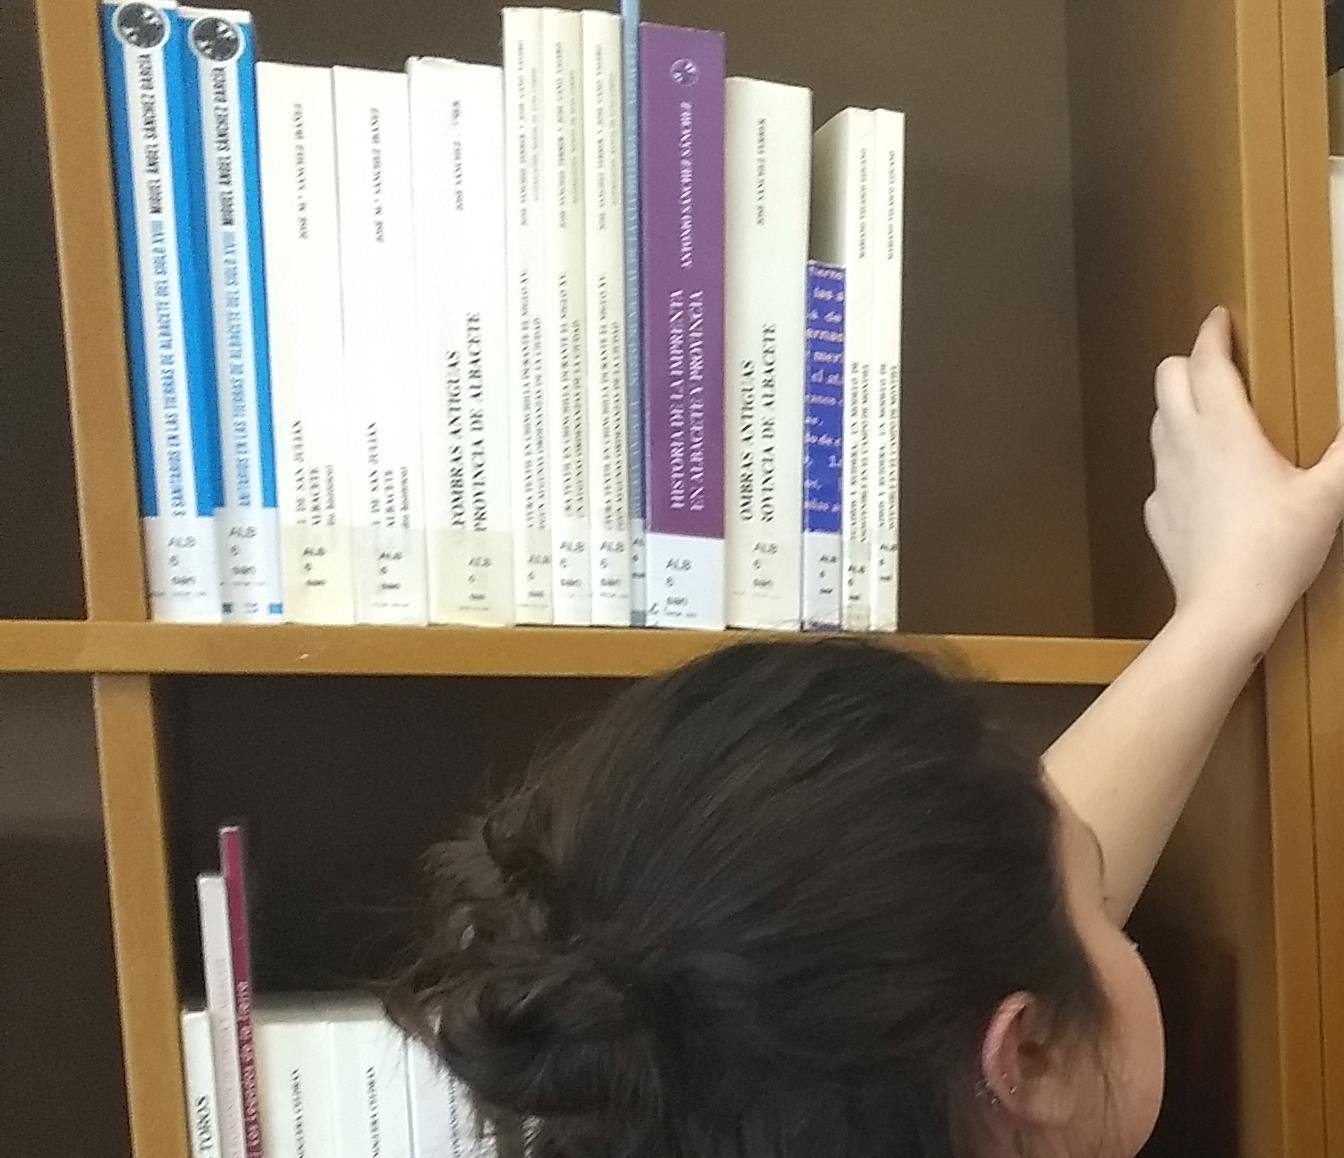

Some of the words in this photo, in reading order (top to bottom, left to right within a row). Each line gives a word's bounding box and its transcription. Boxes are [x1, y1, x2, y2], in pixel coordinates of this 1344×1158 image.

[147, 176, 163, 213] MIGUEL
[680, 214, 692, 266] ANTONIO
[155, 279, 169, 296] DEL
[157, 301, 173, 351] ALBACETE
[670, 289, 684, 374] IMPRENTA
[688, 290, 703, 379] PROVINCIA
[161, 354, 174, 365] DE
[466, 311, 485, 398] ALBACETE
[761, 322, 774, 406] ALBACETE
[162, 368, 178, 408] TIERRAS
[446, 350, 463, 438] ANTIGUAS
[670, 378, 684, 398] LA
[689, 386, 703, 395] Y
[740, 360, 753, 444] ANTIGUAS
[165, 411, 179, 431] LAS
[468, 408, 485, 431] DE
[670, 403, 684, 426] DE
[761, 416, 774, 438] DE
[167, 434, 181, 447] EN
[689, 397, 704, 479] ALBACETE
[468, 439, 487, 530] PROVINCIA
[670, 430, 684, 507] HISTORIA
[690, 486, 704, 509] EN
[196, 1095, 213, 1151] TOROS
